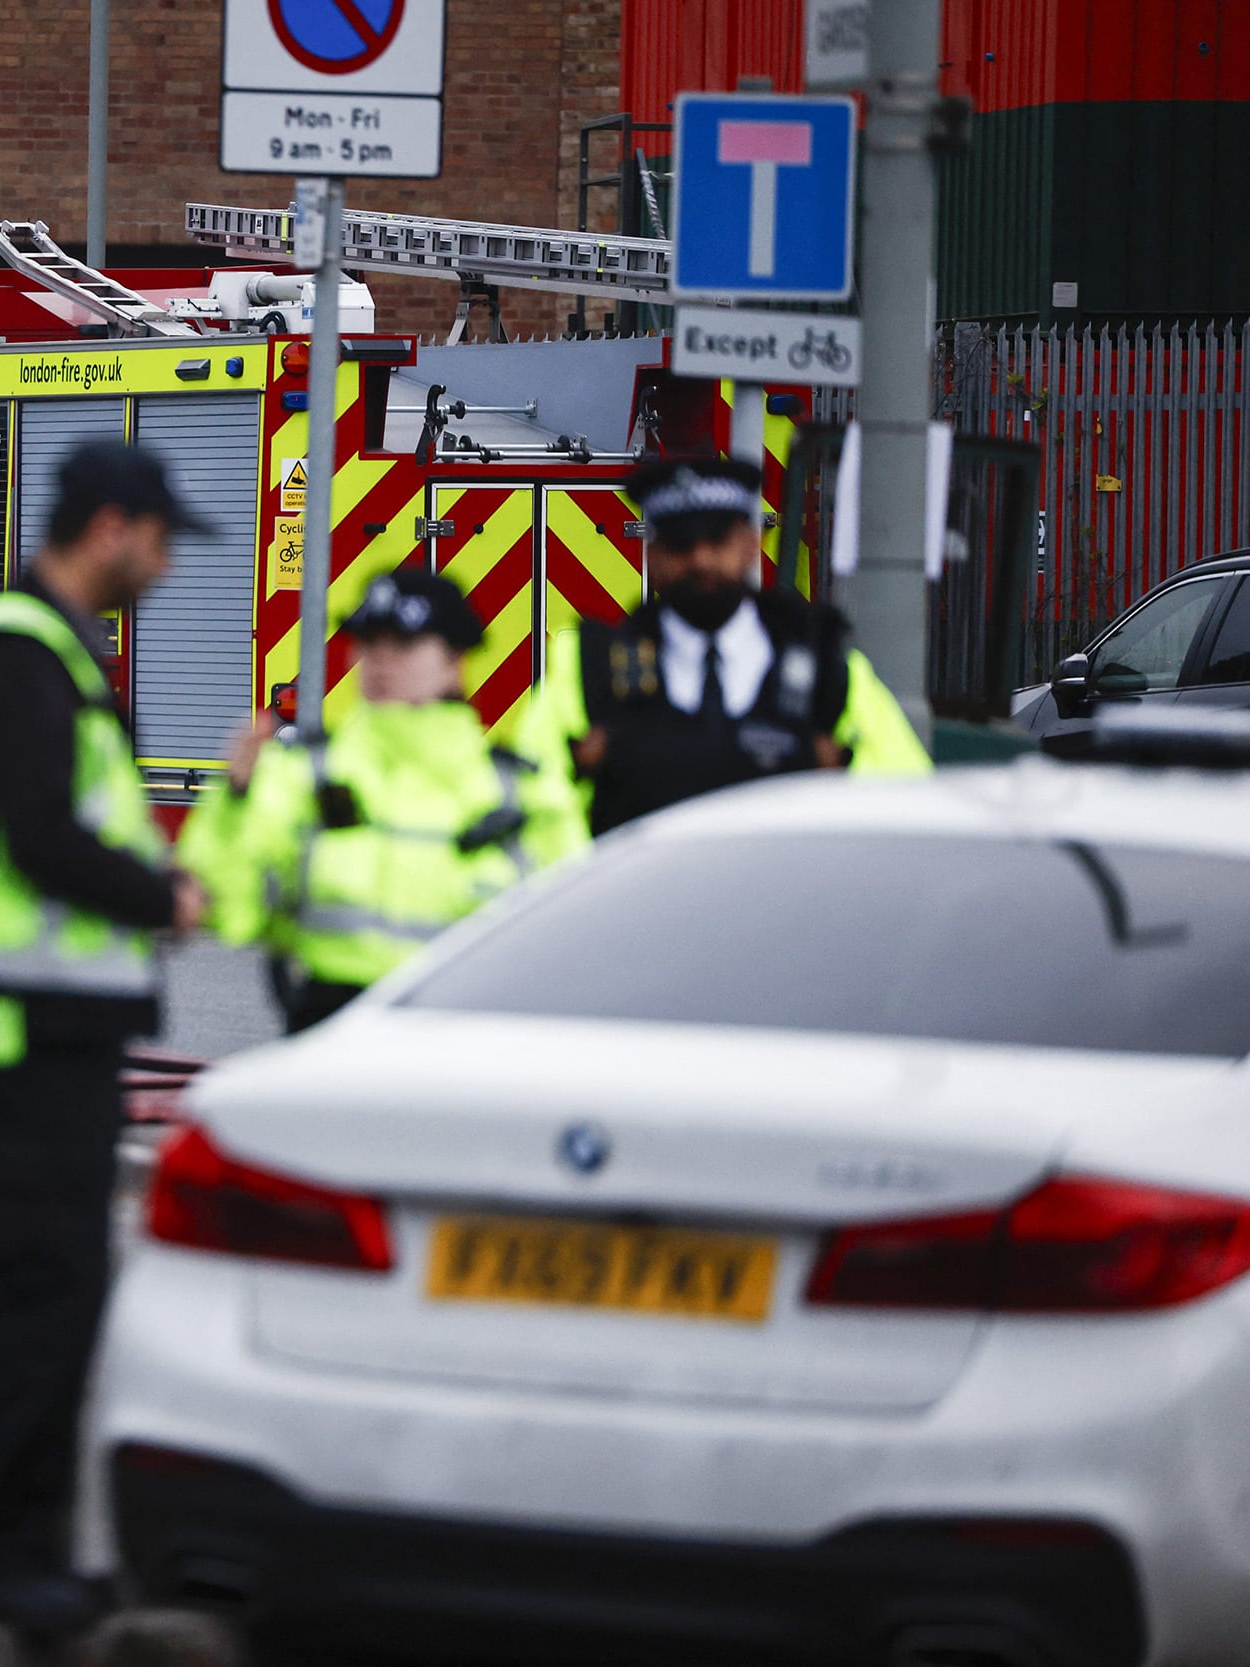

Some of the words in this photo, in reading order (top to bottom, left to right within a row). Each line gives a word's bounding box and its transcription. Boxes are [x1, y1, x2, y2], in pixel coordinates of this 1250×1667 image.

[284, 107, 332, 128] Mon
[351, 107, 380, 128] Fri
[685, 325, 777, 361] Except
[19, 355, 123, 390] london-fire.gov.uk
[279, 523, 306, 535] Cycli
[279, 565, 295, 574] Stay
